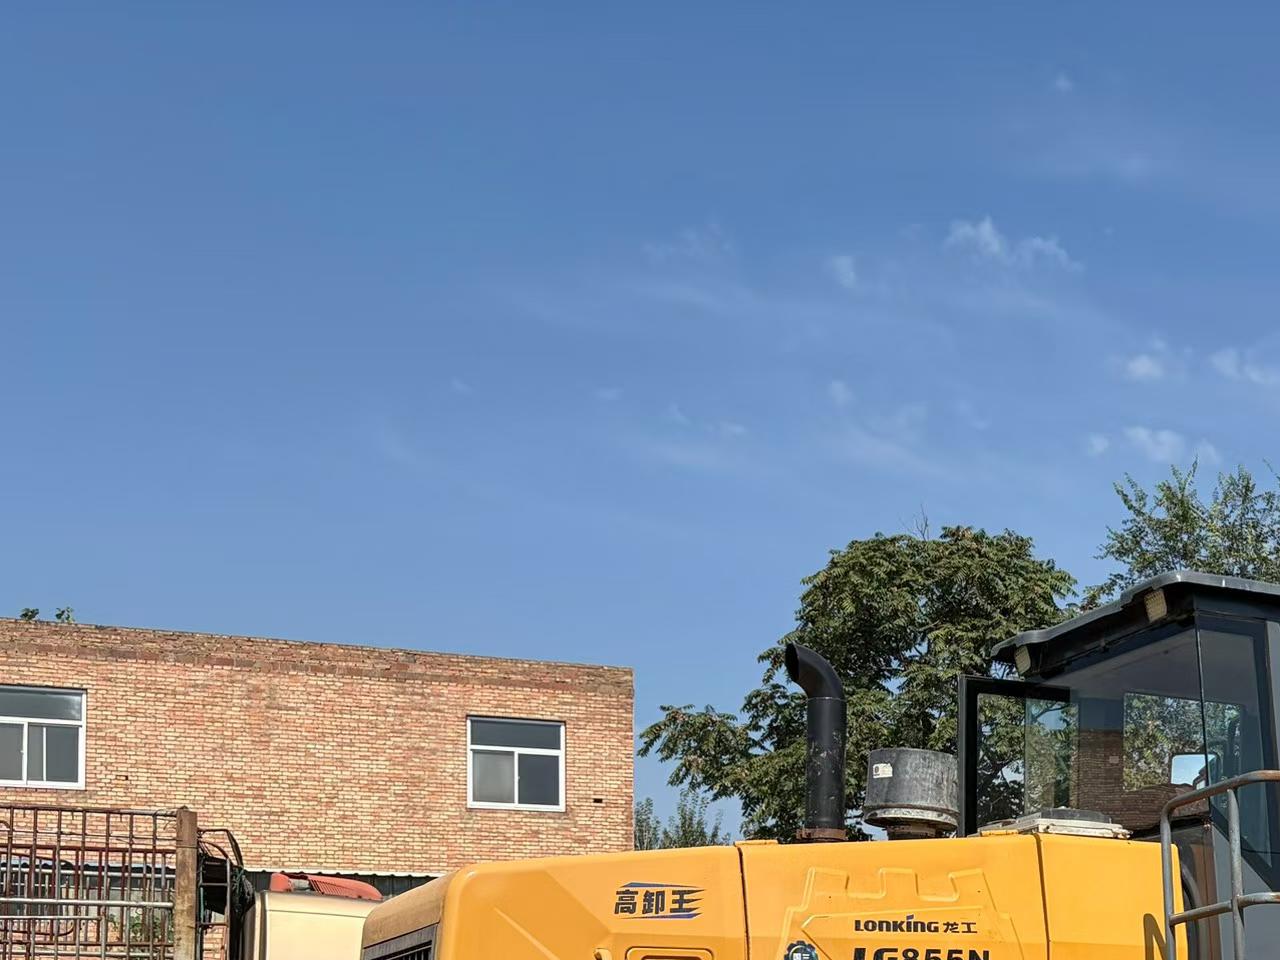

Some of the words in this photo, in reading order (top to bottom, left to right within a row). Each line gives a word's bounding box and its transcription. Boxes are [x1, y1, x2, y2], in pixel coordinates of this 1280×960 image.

[614, 889, 706, 914] 高卸王
[943, 921, 978, 933] 龙工
